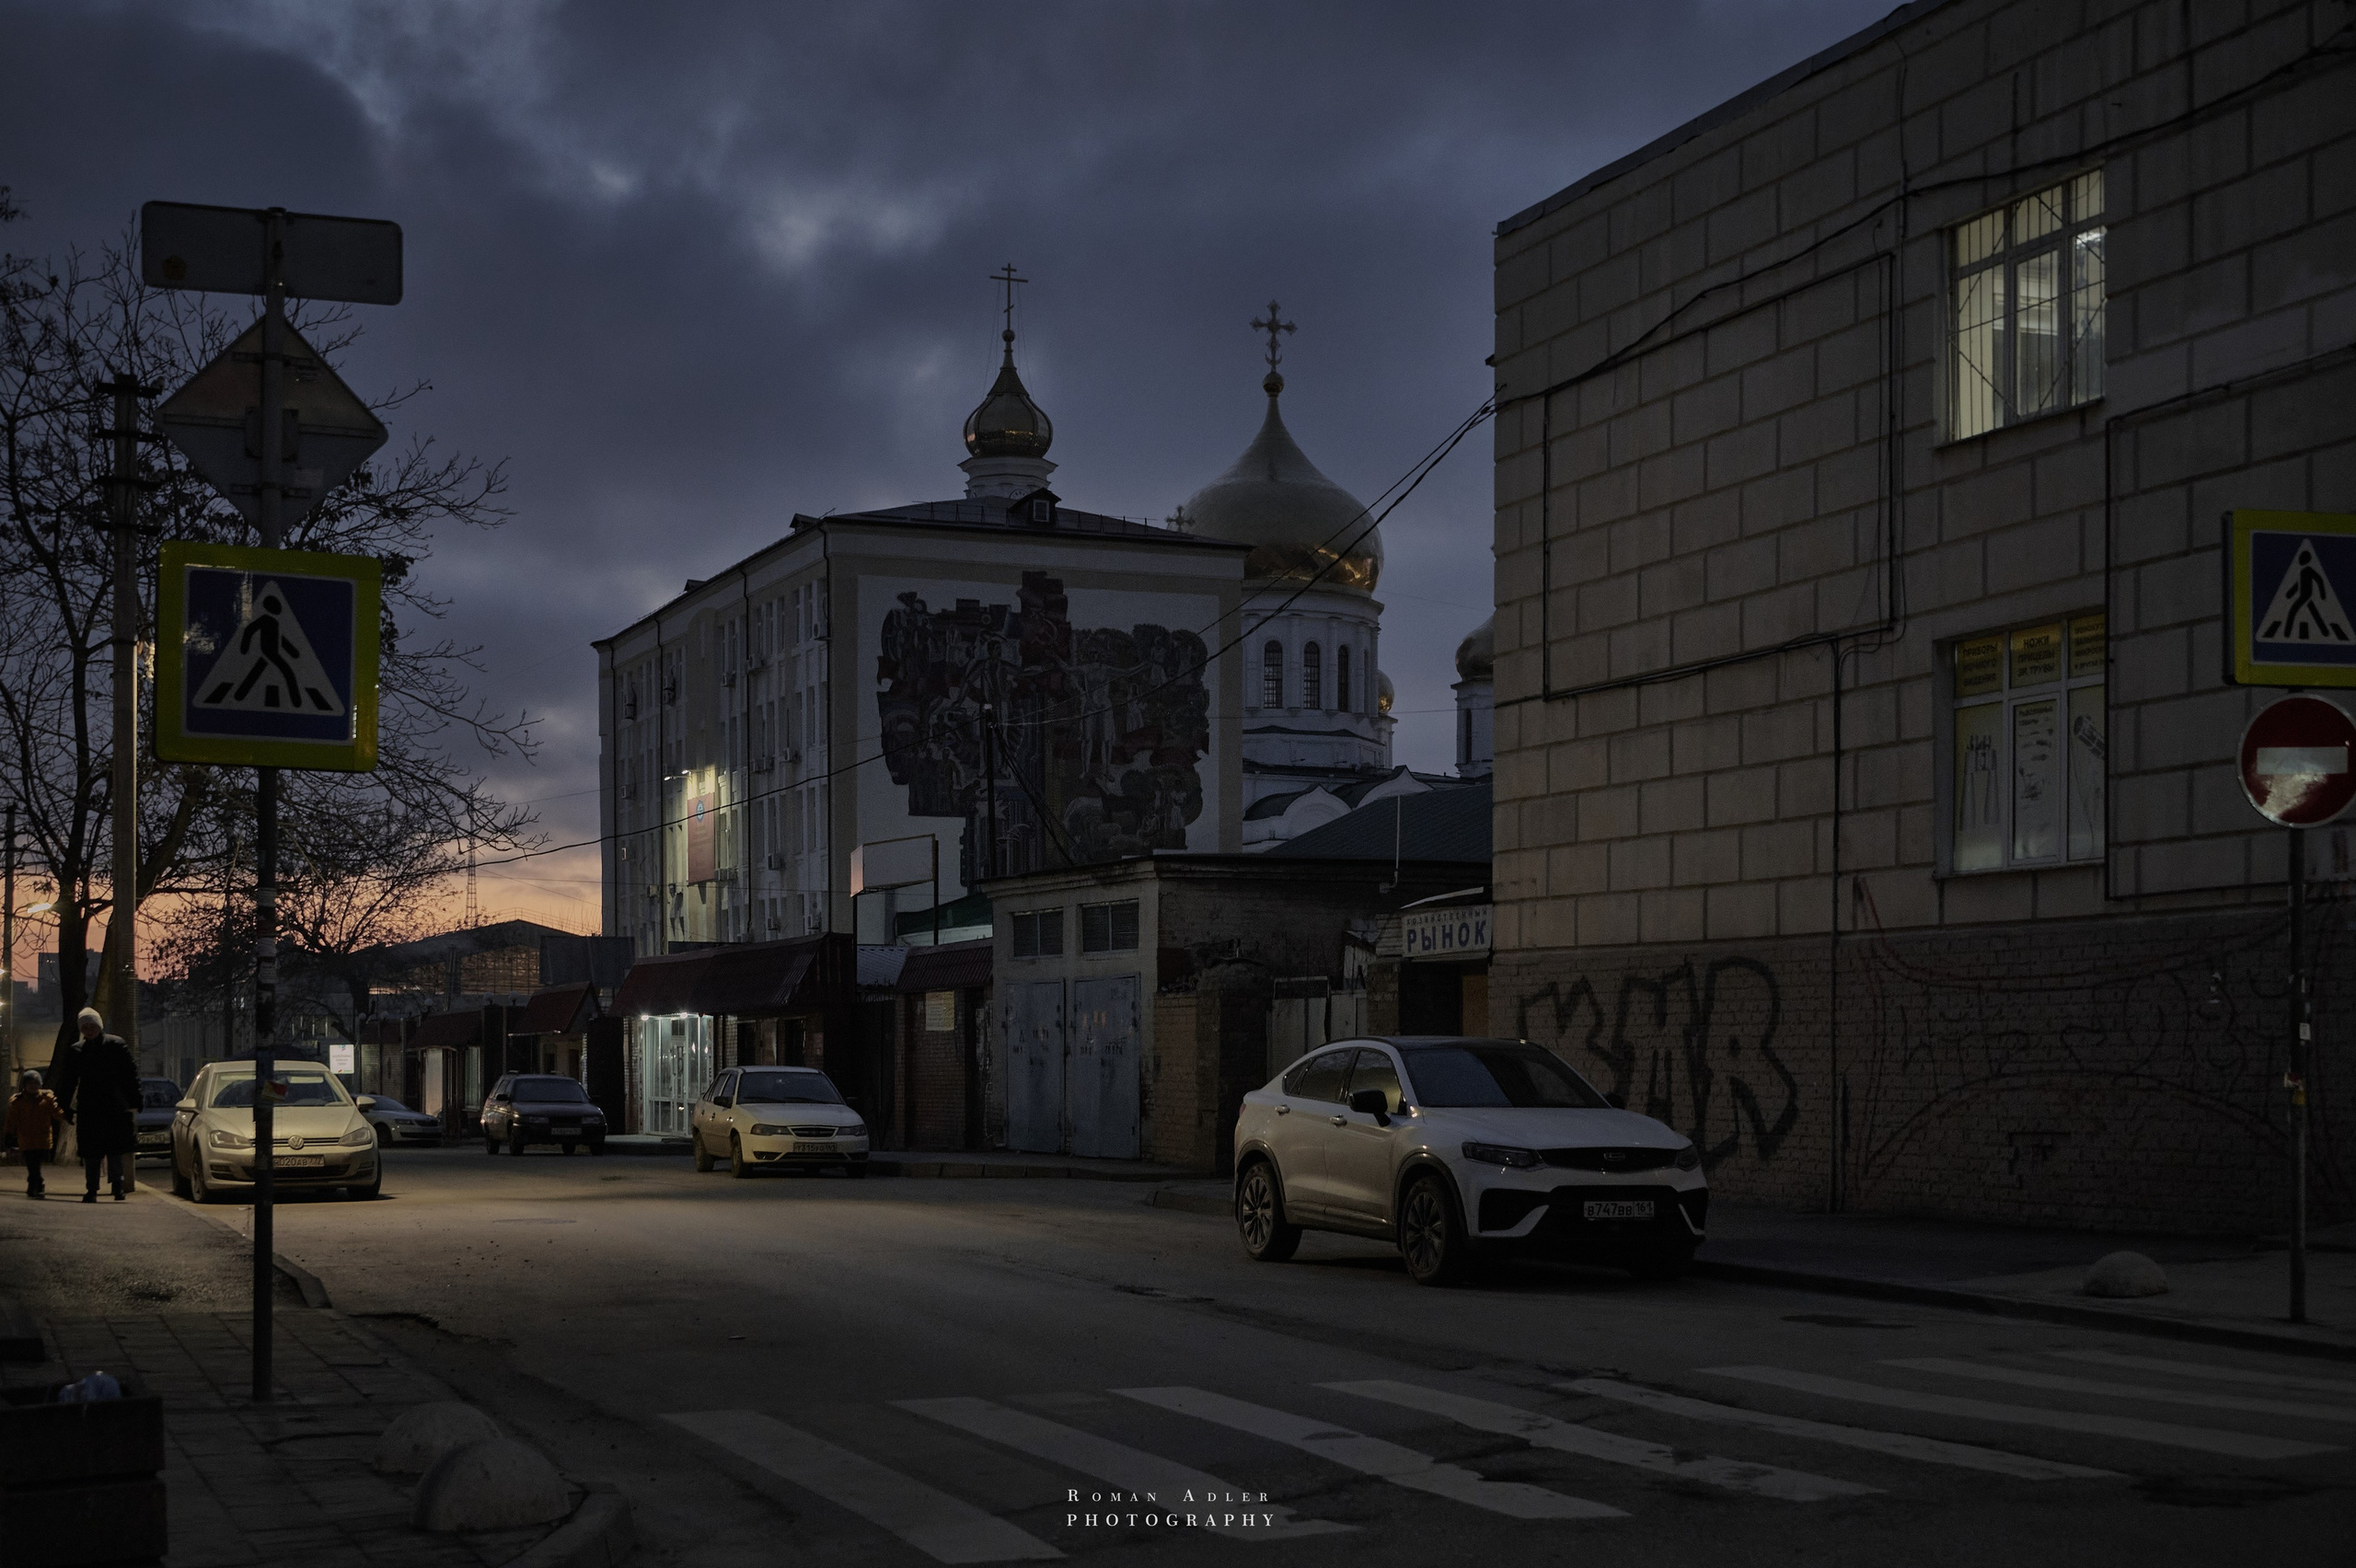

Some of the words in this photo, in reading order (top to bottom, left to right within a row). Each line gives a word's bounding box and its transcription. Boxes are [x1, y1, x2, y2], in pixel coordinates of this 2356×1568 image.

[1963, 641, 1998, 657] ПРИБОРЫ
[2024, 635, 2050, 649] НОЖИ
[2018, 650, 2055, 663] ПРИЦЕЛЫ
[1406, 920, 1487, 952] РЫНОК
[1588, 1203, 1633, 1216] В747ВВ
